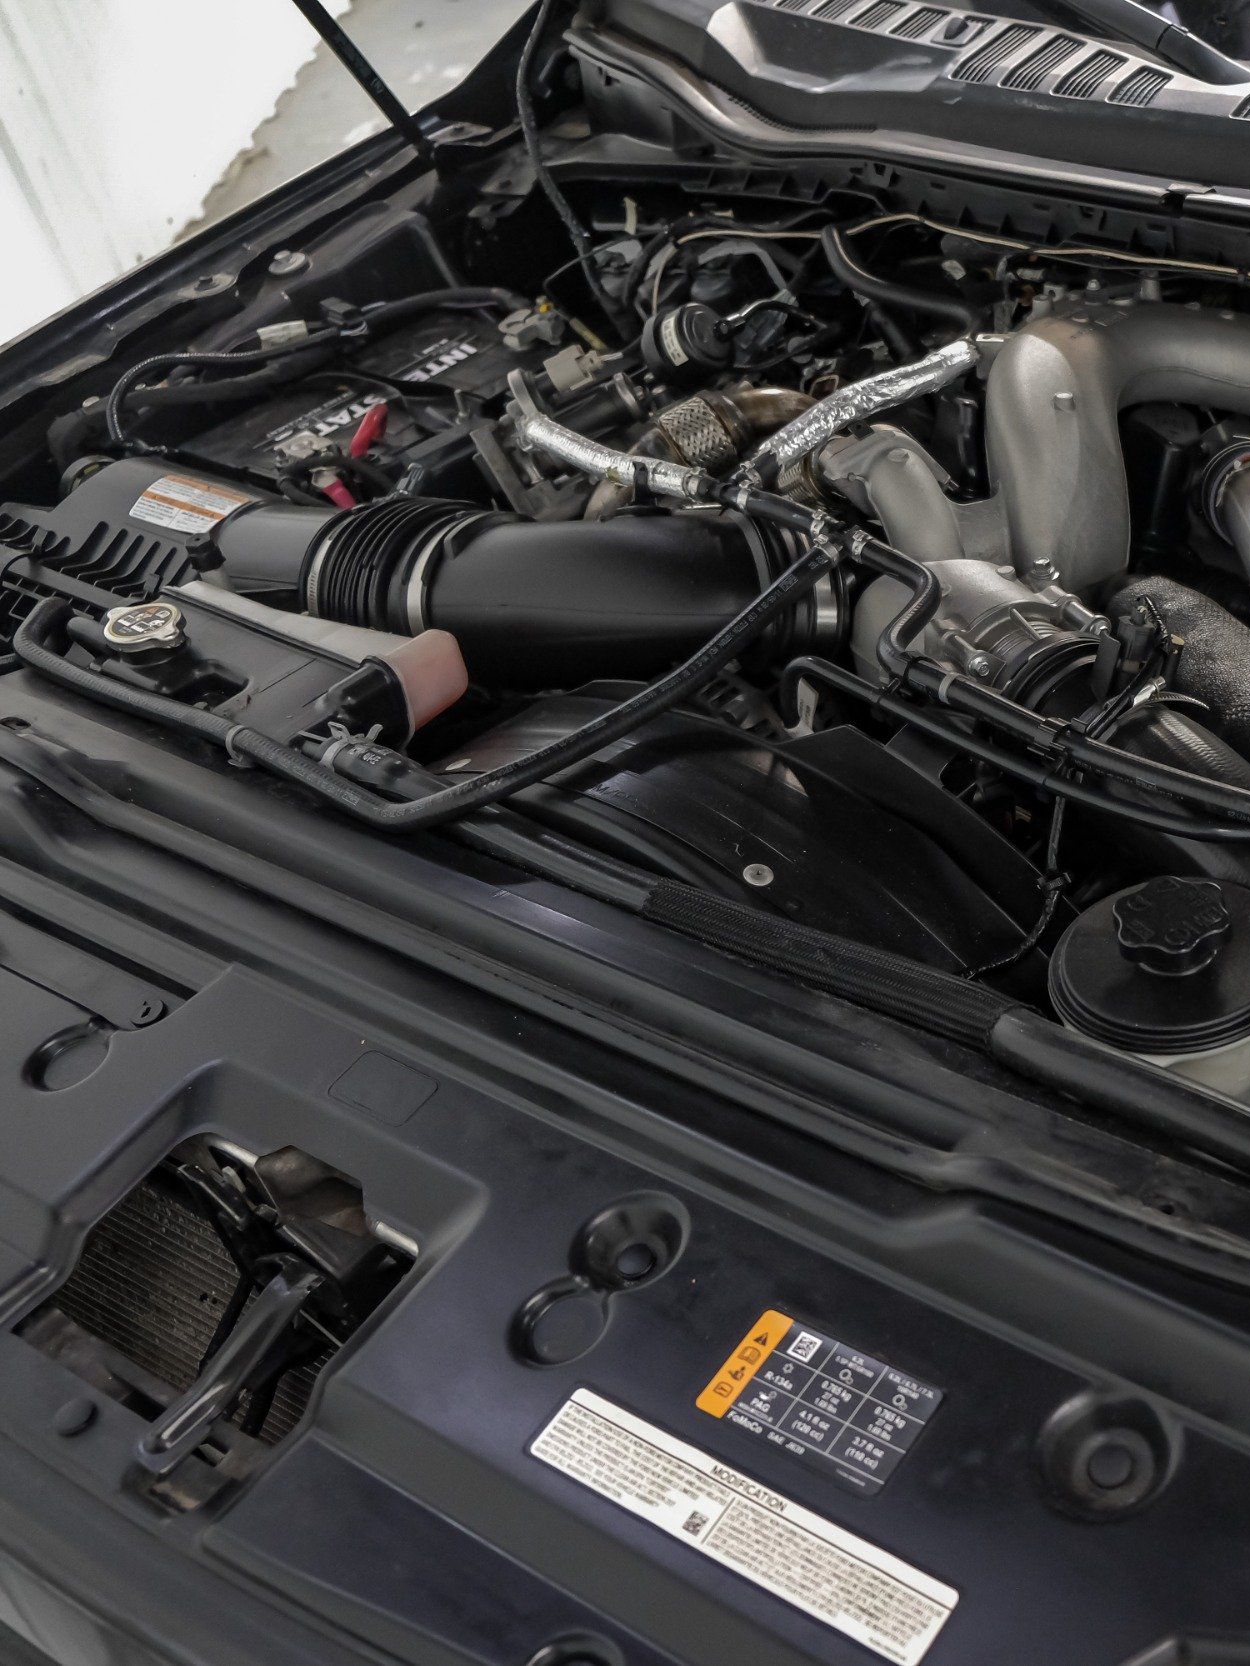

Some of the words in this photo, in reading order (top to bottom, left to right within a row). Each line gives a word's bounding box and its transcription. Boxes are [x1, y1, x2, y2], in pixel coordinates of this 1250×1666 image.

[763, 1369, 795, 1391] R-134a
[748, 1396, 771, 1413] PAG
[725, 1410, 764, 1435] FoMoCo
[766, 1430, 785, 1445] SAE
[710, 1464, 788, 1511] MODIFICATION
